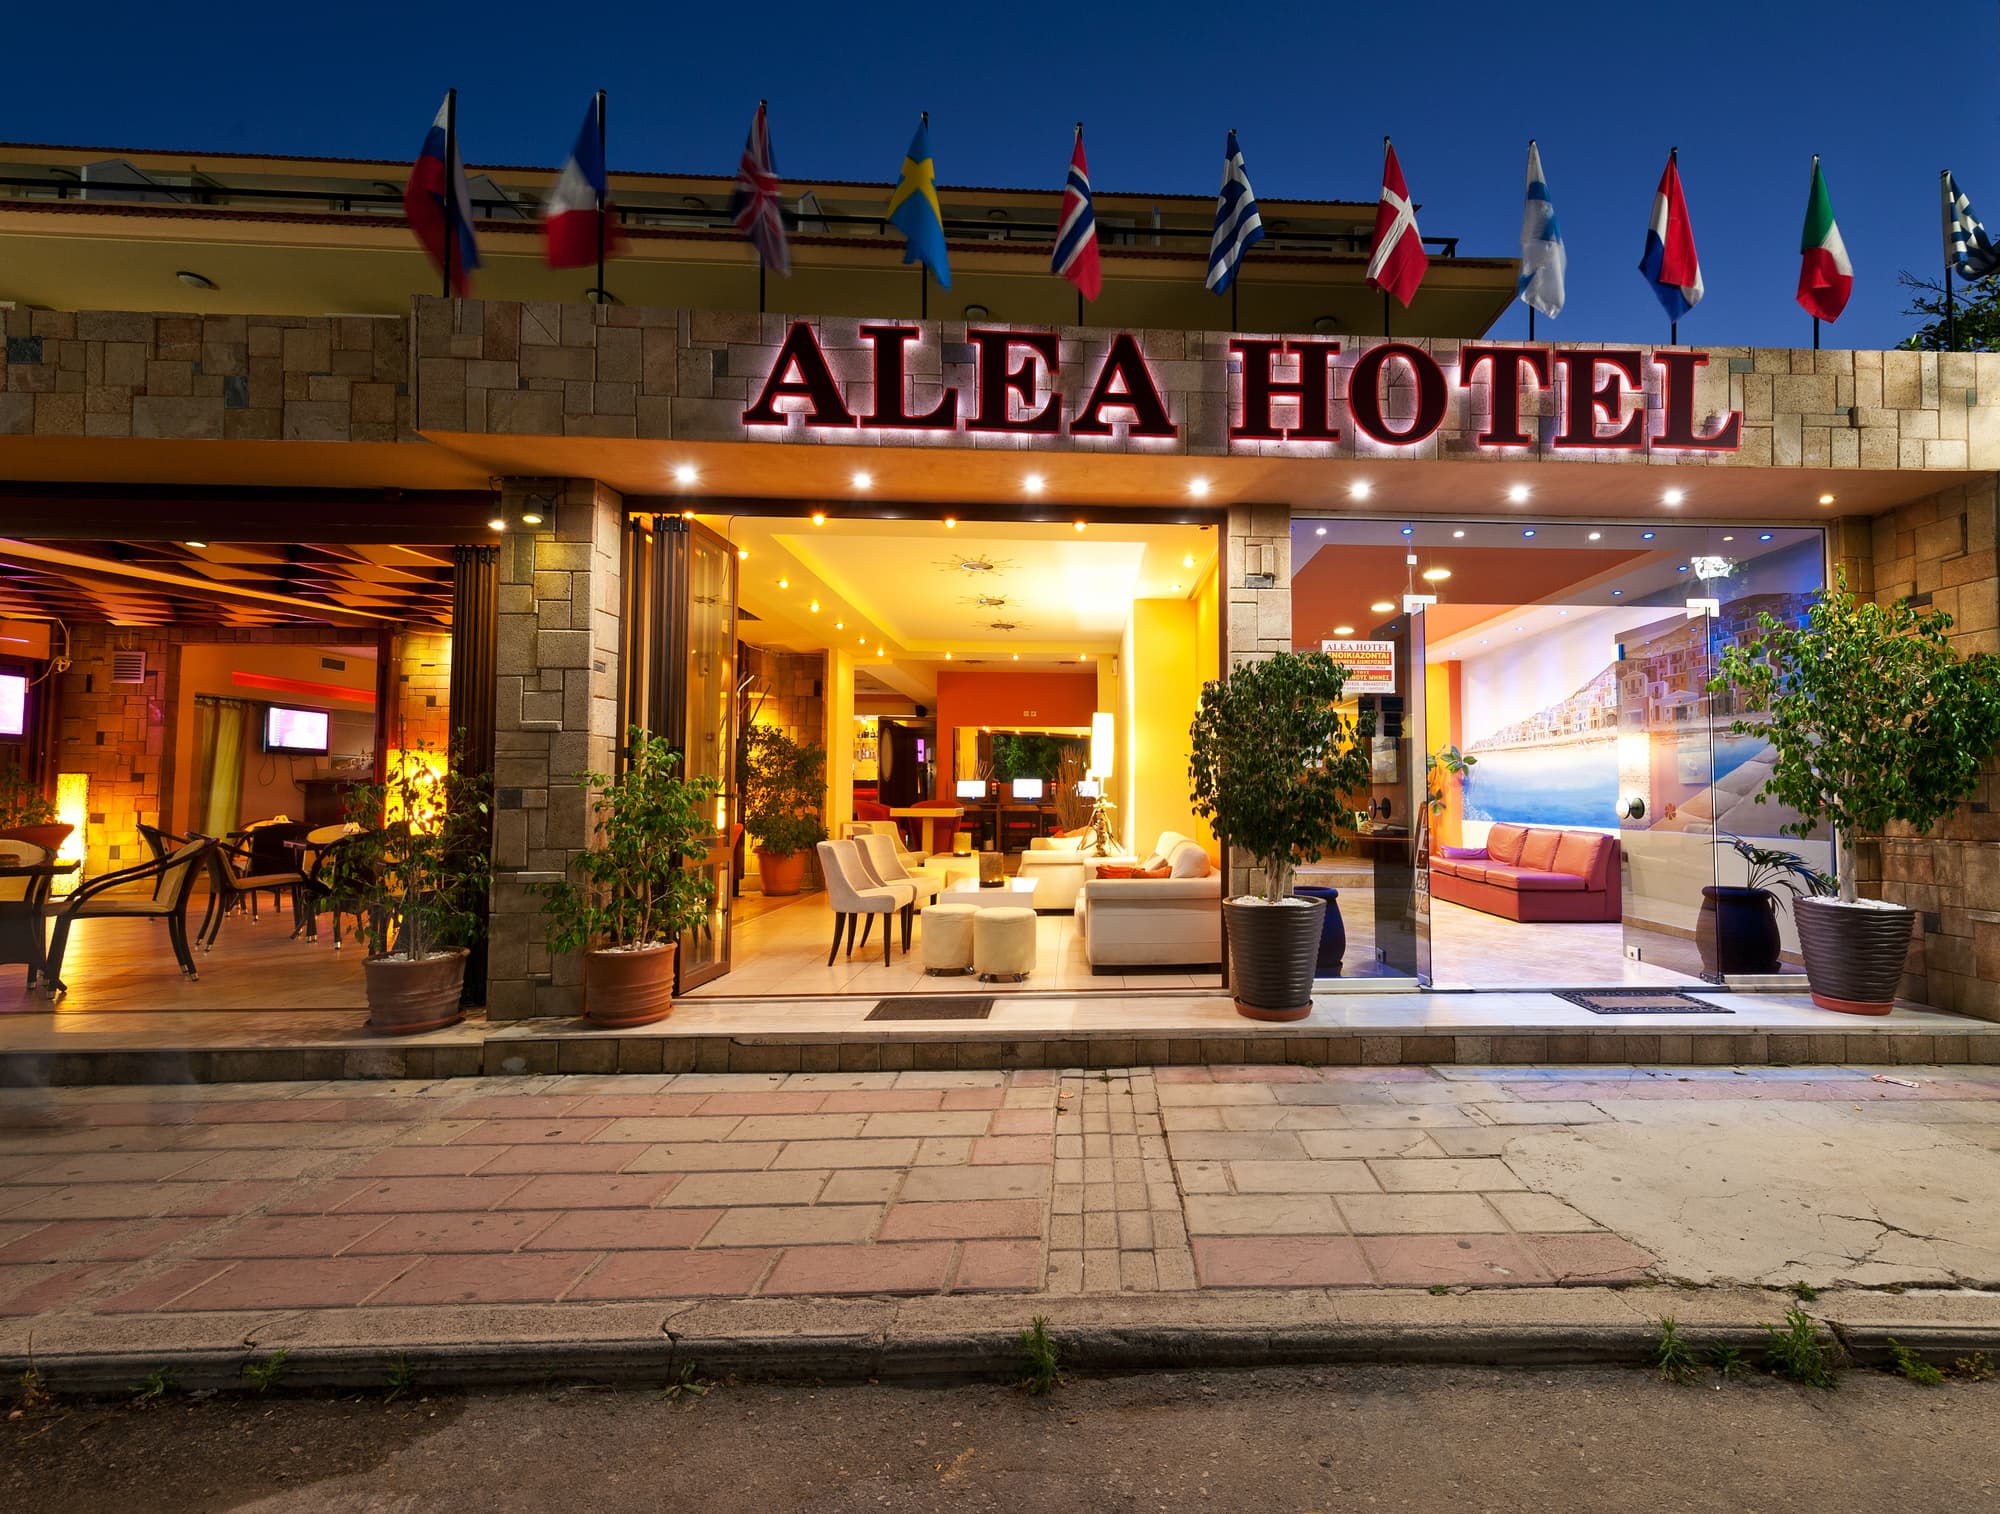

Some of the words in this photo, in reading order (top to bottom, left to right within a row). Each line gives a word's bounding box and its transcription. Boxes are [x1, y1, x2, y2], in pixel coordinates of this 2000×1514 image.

[742, 321, 1178, 438] ALEA
[1229, 338, 1742, 451] HOTEL
[1326, 643, 1354, 651] ALEA
[1356, 643, 1392, 651] HOTEL
